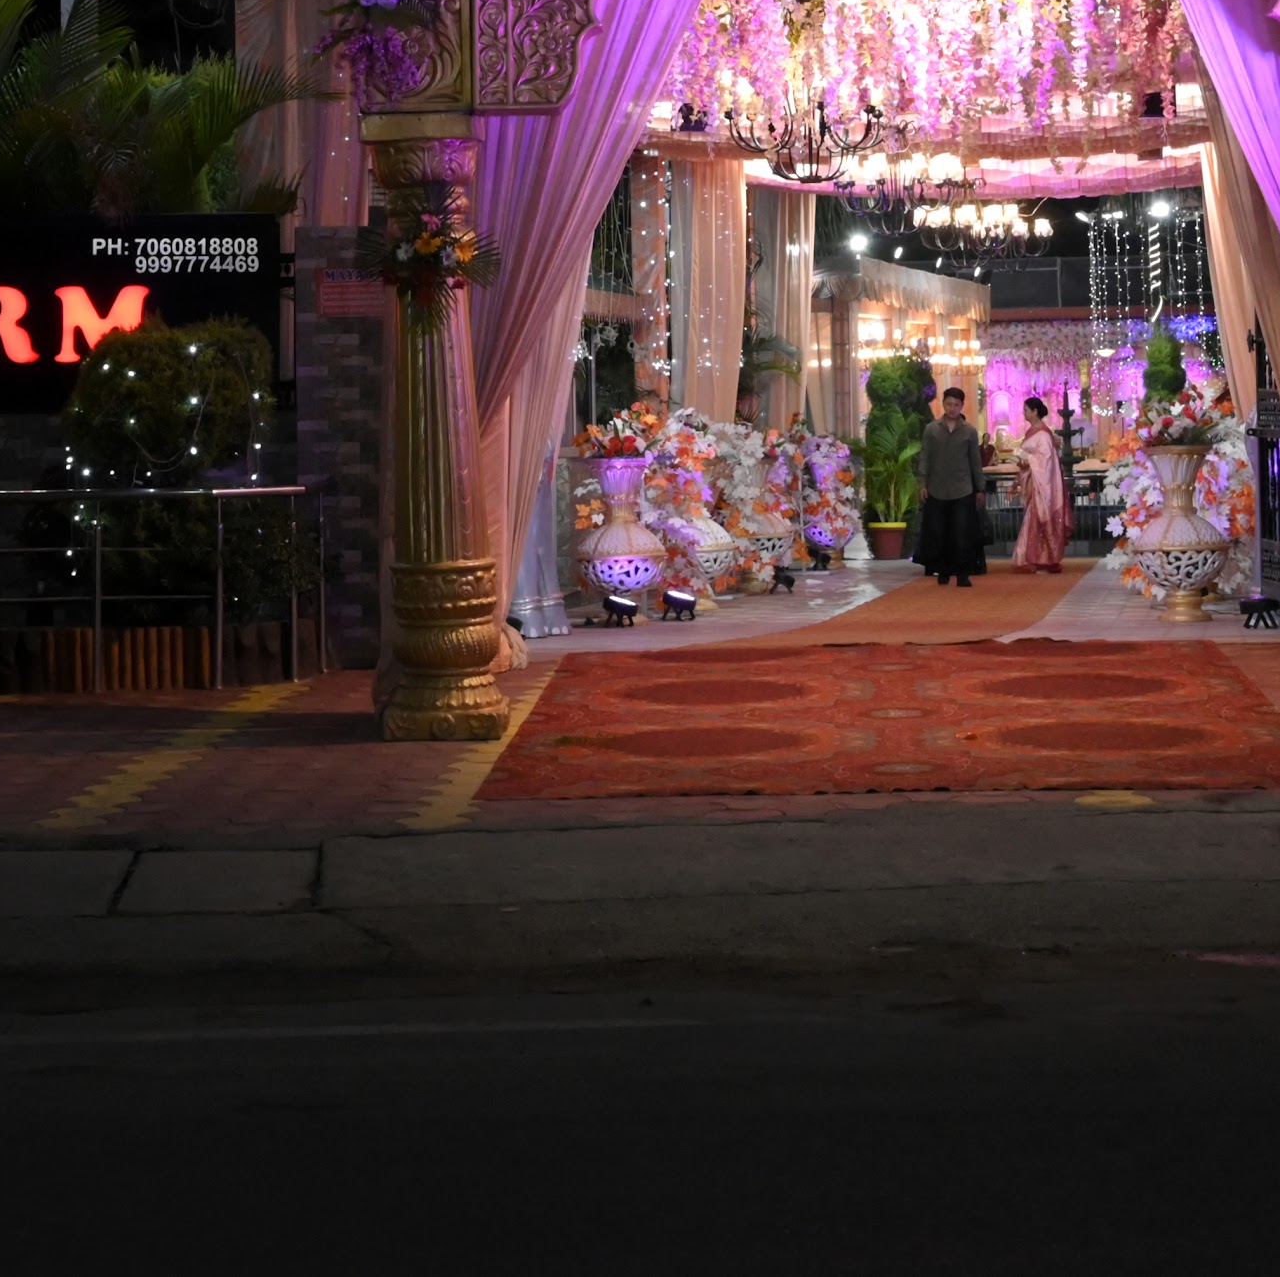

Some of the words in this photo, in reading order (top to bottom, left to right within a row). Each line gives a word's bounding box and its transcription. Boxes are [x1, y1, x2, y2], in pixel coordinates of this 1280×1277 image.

[92, 237, 130, 256] PH:
[134, 237, 259, 255] 7060818808
[135, 255, 260, 273] 9997774469
